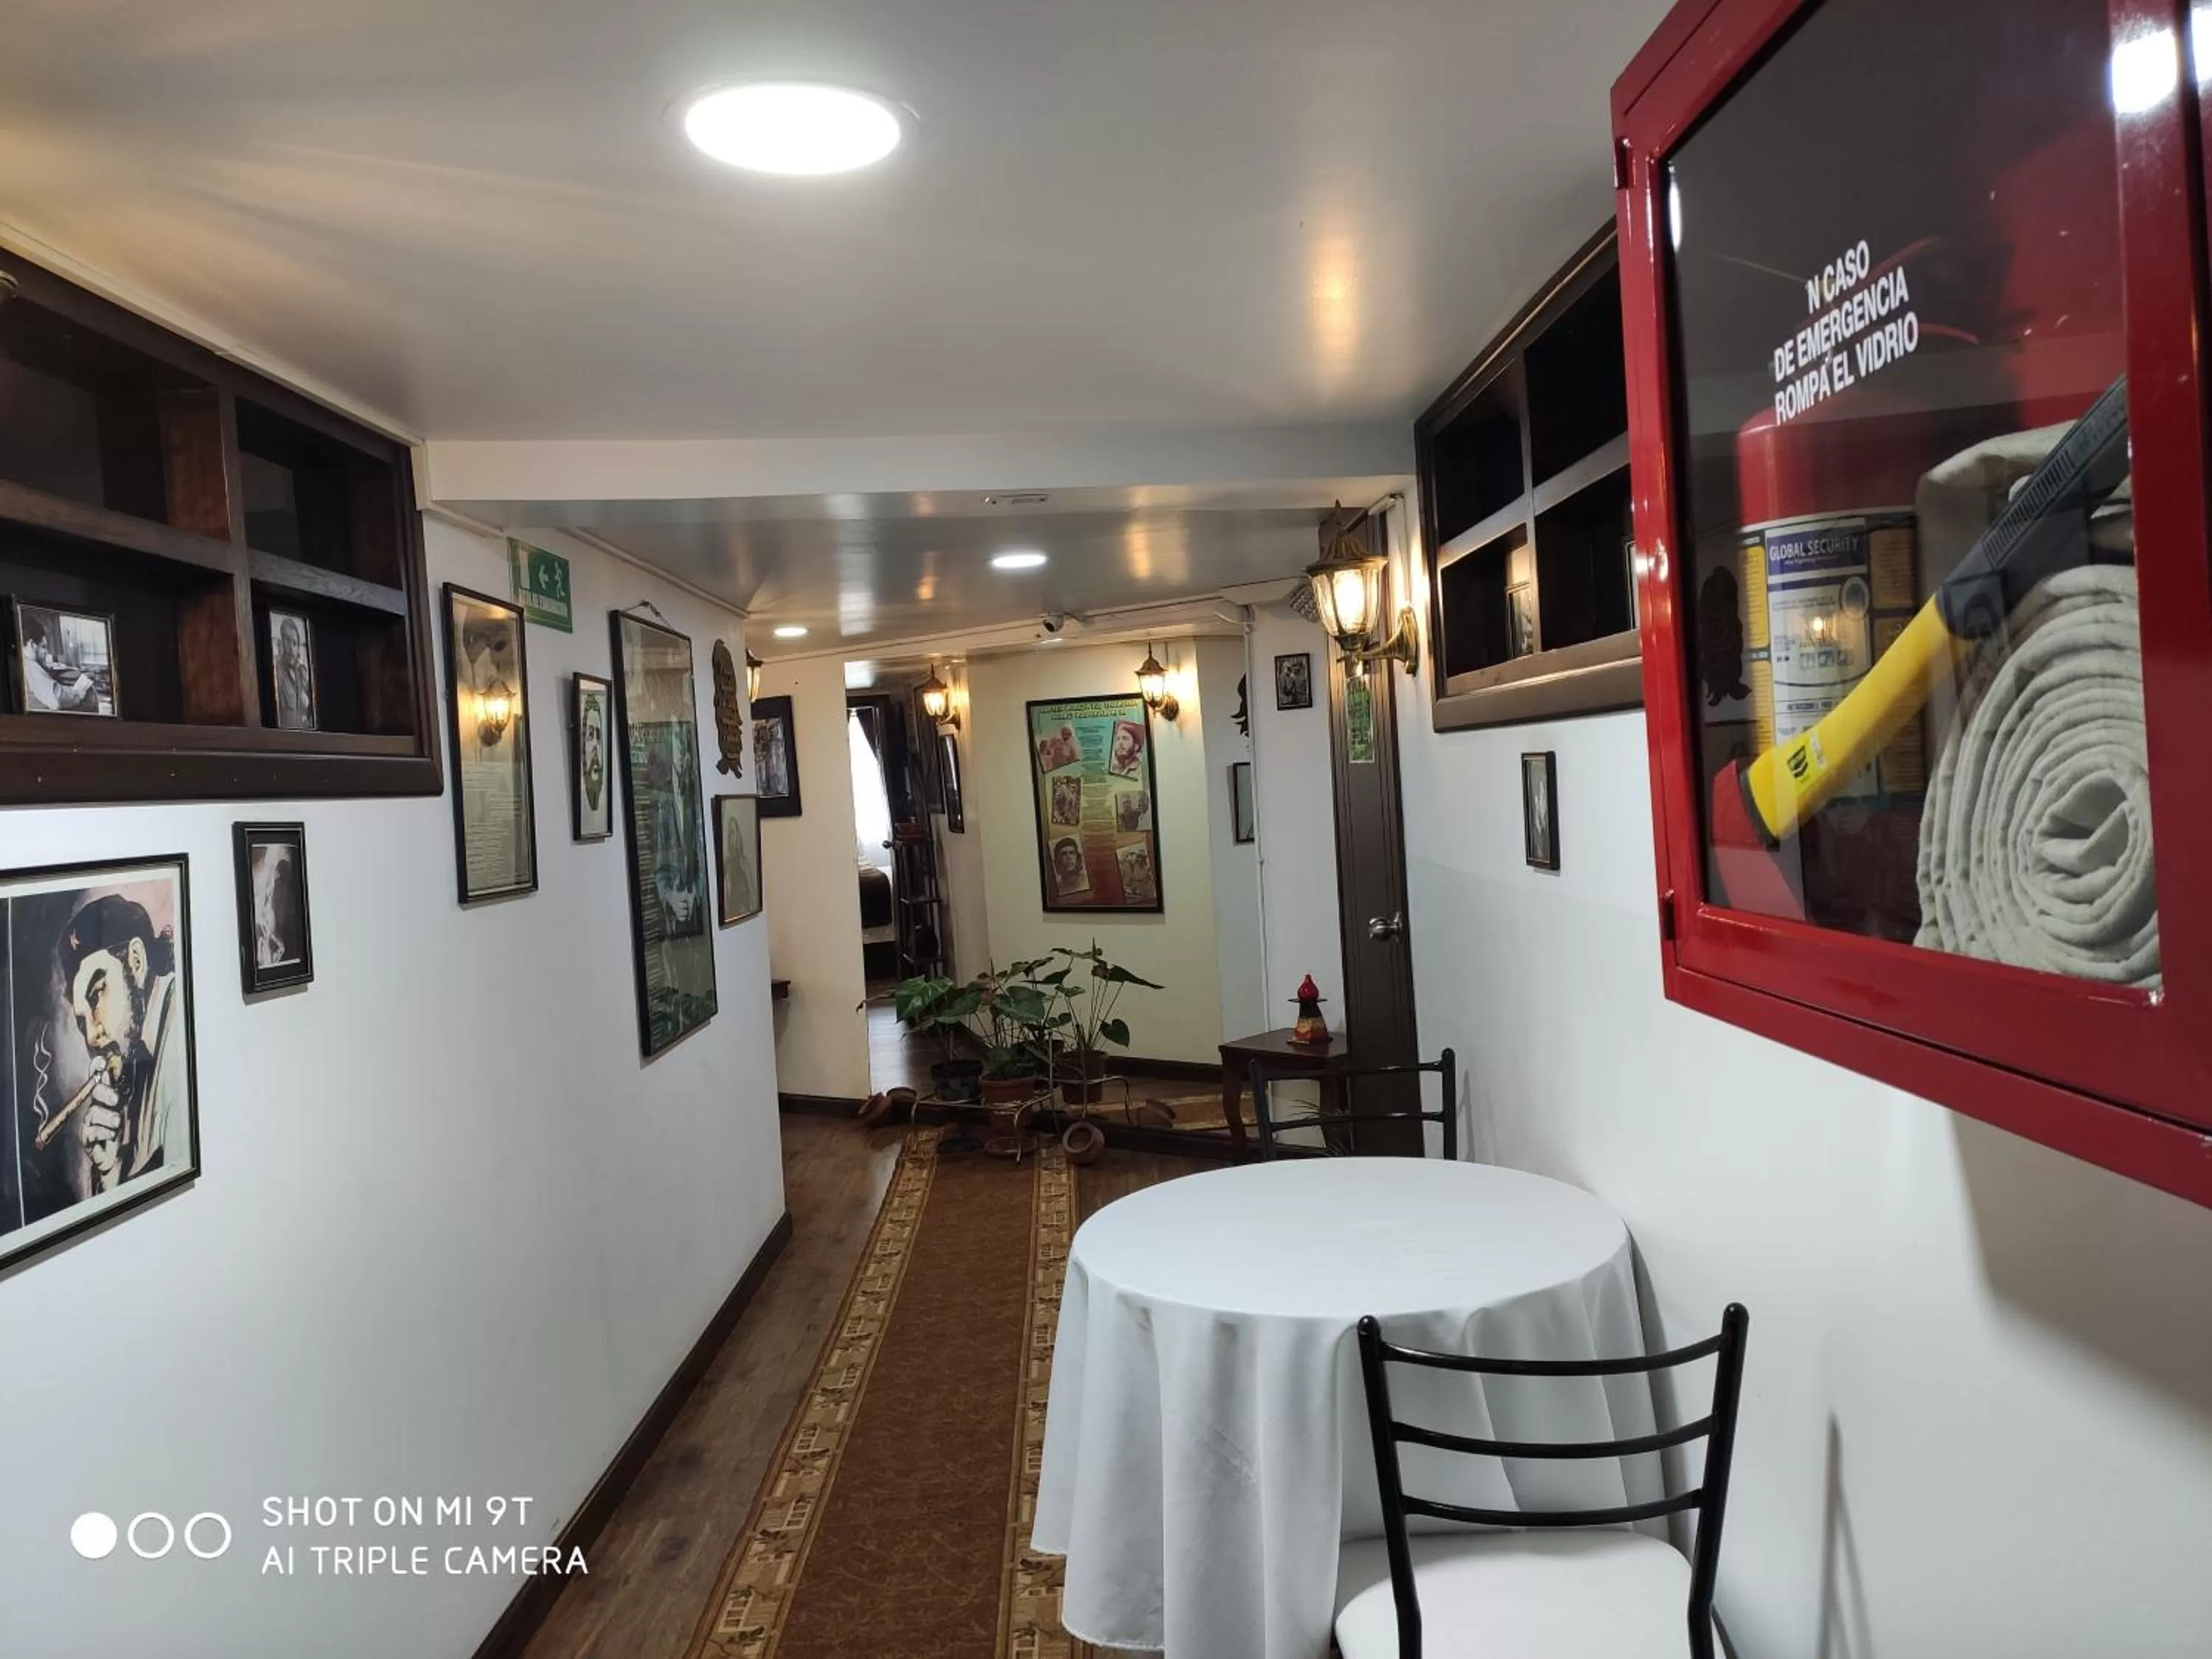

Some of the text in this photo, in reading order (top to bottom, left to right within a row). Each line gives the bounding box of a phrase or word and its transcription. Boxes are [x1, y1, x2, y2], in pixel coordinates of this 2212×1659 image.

[1823, 240, 1870, 302] CASO
[1773, 265, 1910, 383] DE EMERGENCIA
[1832, 350, 1855, 393] EL
[1855, 310, 1919, 378] VIDRIO
[1770, 542, 1806, 561] GLOBAL
